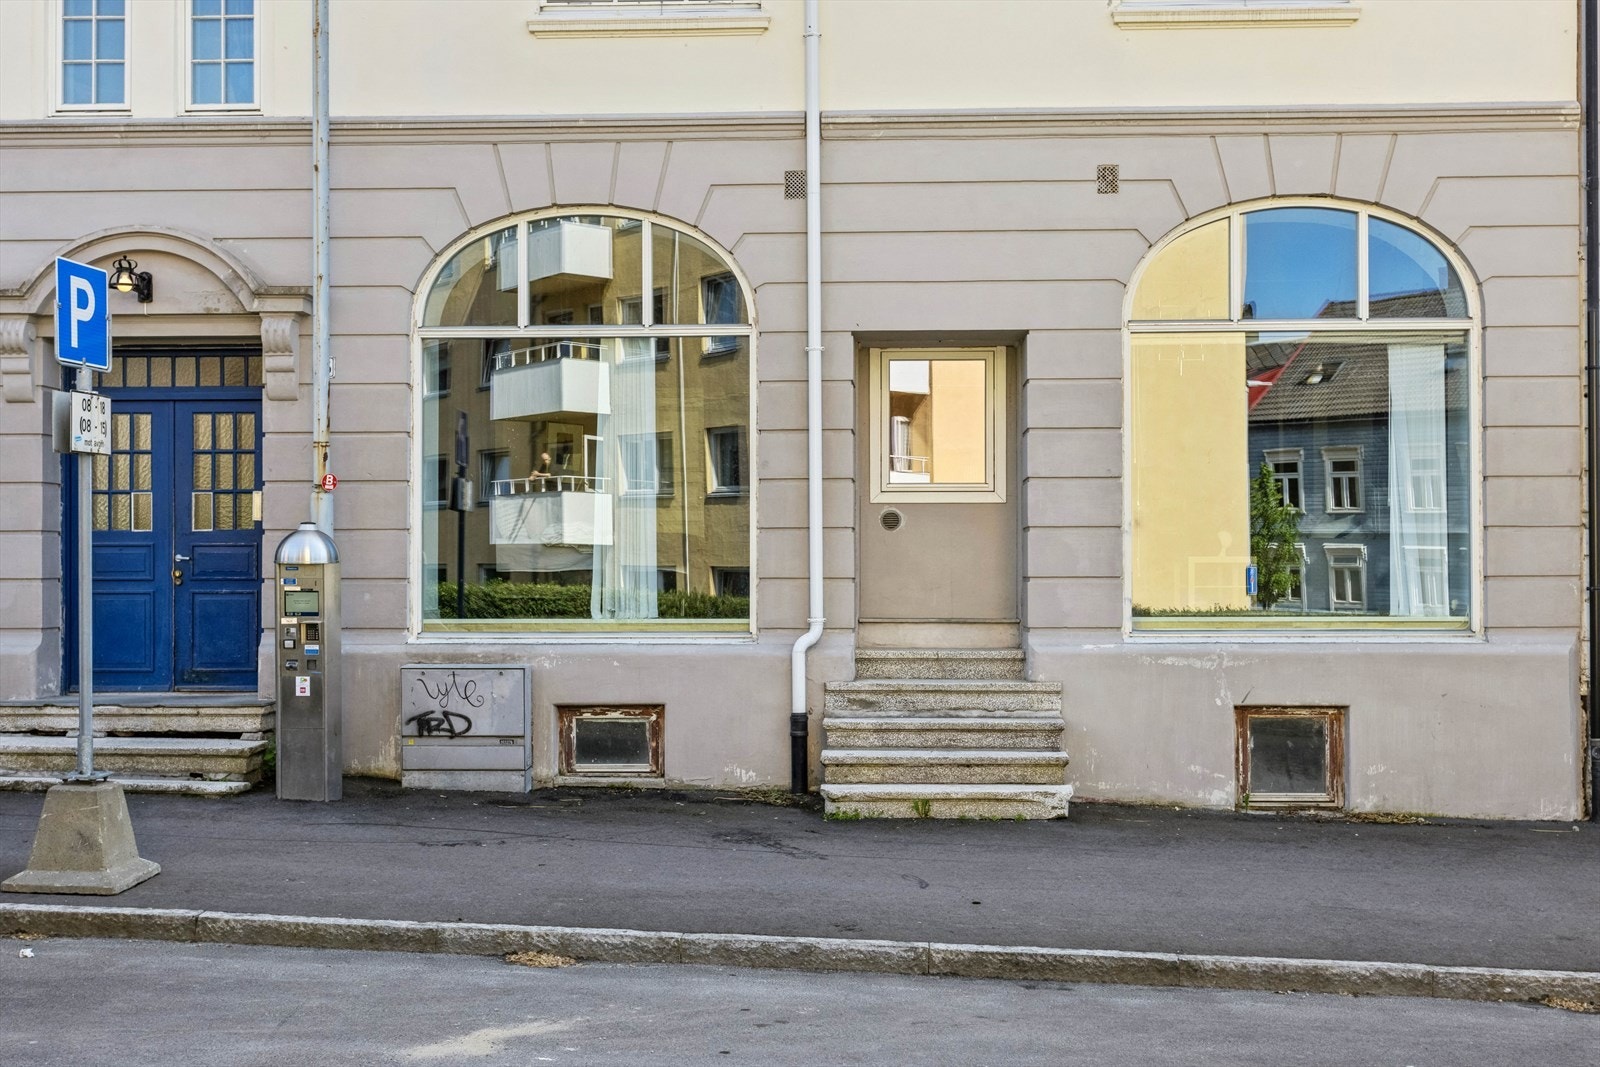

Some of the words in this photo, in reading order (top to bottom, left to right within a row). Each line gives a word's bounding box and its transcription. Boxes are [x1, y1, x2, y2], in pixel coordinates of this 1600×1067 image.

[70, 275, 96, 348] P
[82, 398, 92, 412] 08
[100, 401, 106, 415] 18
[80, 416, 91, 434] (08
[326, 474, 334, 485] B
